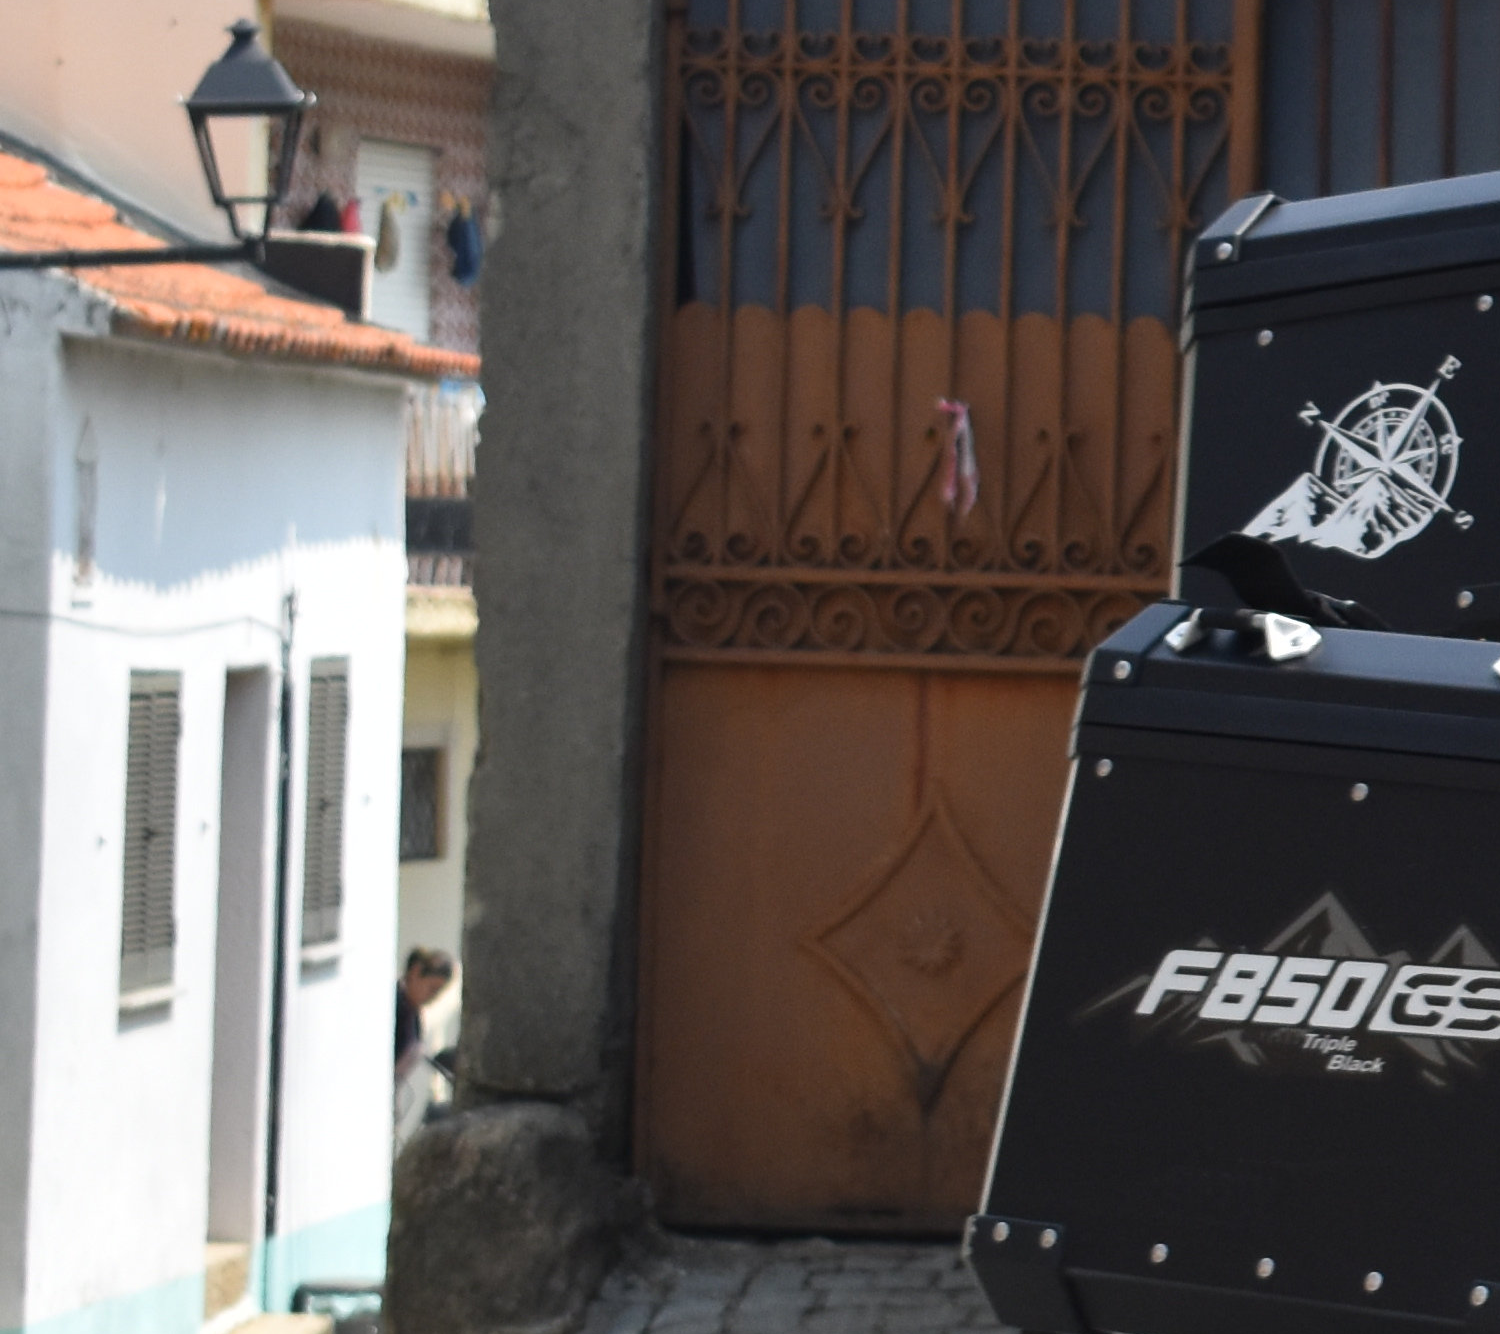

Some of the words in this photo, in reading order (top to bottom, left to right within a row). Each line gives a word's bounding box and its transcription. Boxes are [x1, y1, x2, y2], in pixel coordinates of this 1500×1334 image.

[1453, 509, 1475, 530] S
[1302, 1032, 1358, 1055] Triple
[1325, 1053, 1387, 1074] Black
